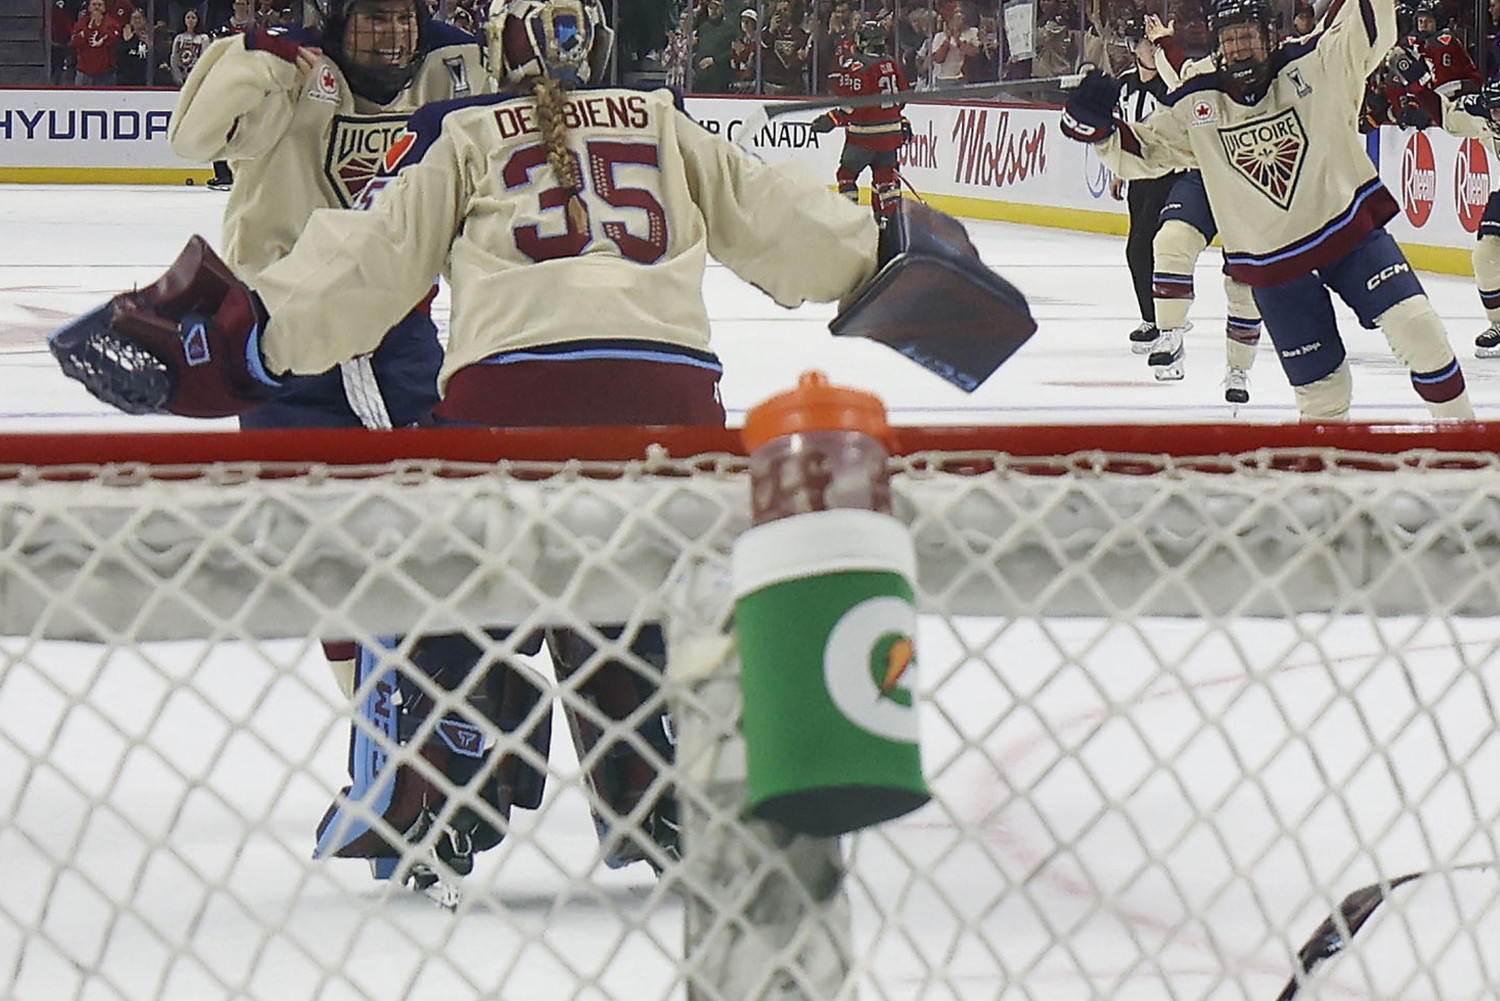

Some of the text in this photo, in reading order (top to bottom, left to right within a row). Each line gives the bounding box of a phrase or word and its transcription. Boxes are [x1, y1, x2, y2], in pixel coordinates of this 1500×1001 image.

[1442, 53, 1452, 67] 6
[0, 109, 173, 141] YUNDA
[496, 96, 648, 139] DEBIENS
[727, 120, 820, 149] CNADA
[953, 108, 1047, 188] Molson
[1225, 117, 1298, 154] VICTOIRE
[502, 141, 668, 265] 35
[1366, 262, 1410, 291] CCM
